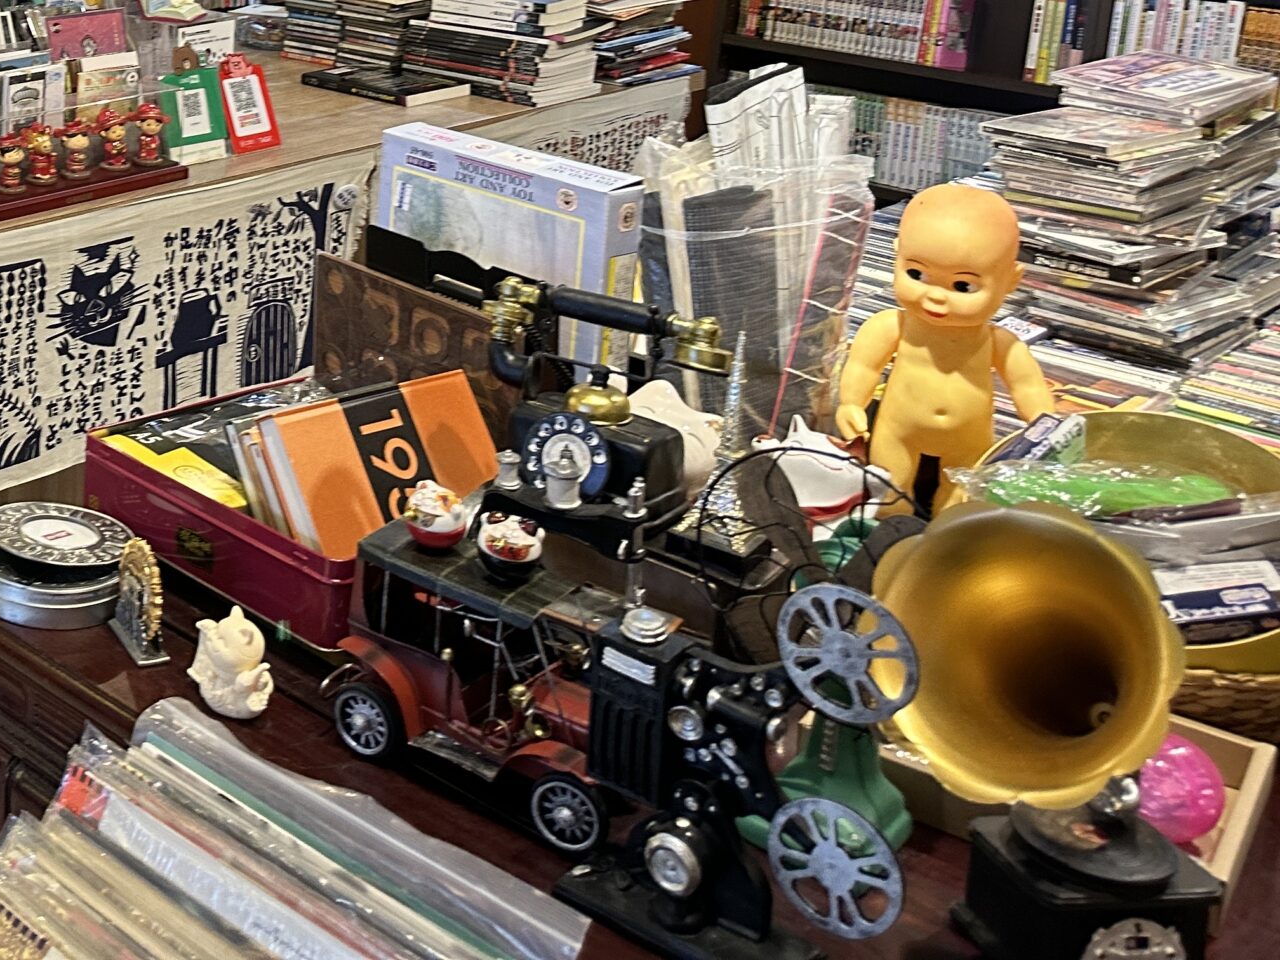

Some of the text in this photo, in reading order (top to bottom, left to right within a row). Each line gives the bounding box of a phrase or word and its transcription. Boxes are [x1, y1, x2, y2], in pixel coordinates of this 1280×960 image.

[455, 171, 536, 203] TOY AND ART
[458, 160, 532, 189] COLLECTION
